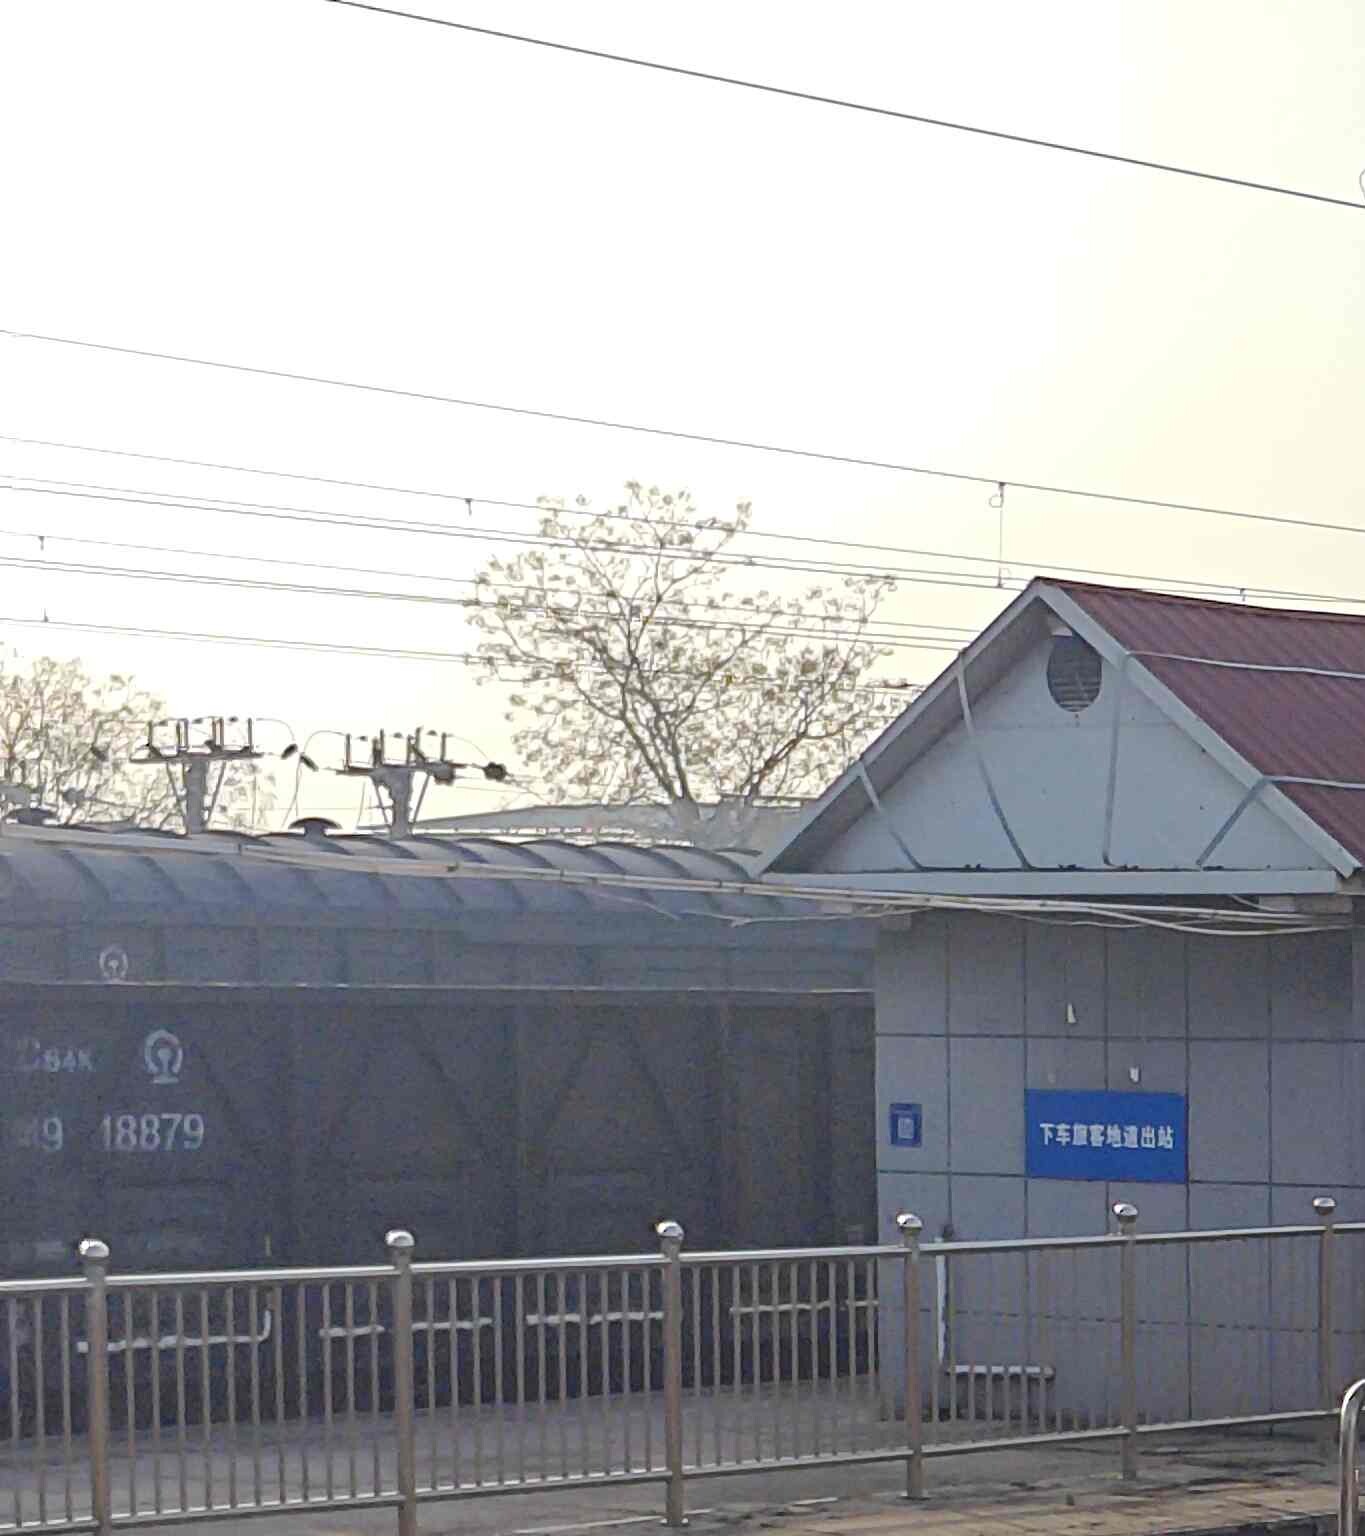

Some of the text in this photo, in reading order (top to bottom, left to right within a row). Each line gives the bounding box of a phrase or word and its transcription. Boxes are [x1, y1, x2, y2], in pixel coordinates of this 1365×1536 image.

[102, 1112, 205, 1151] 18879
[1039, 1121, 1175, 1150] 下车旅客地道出站
